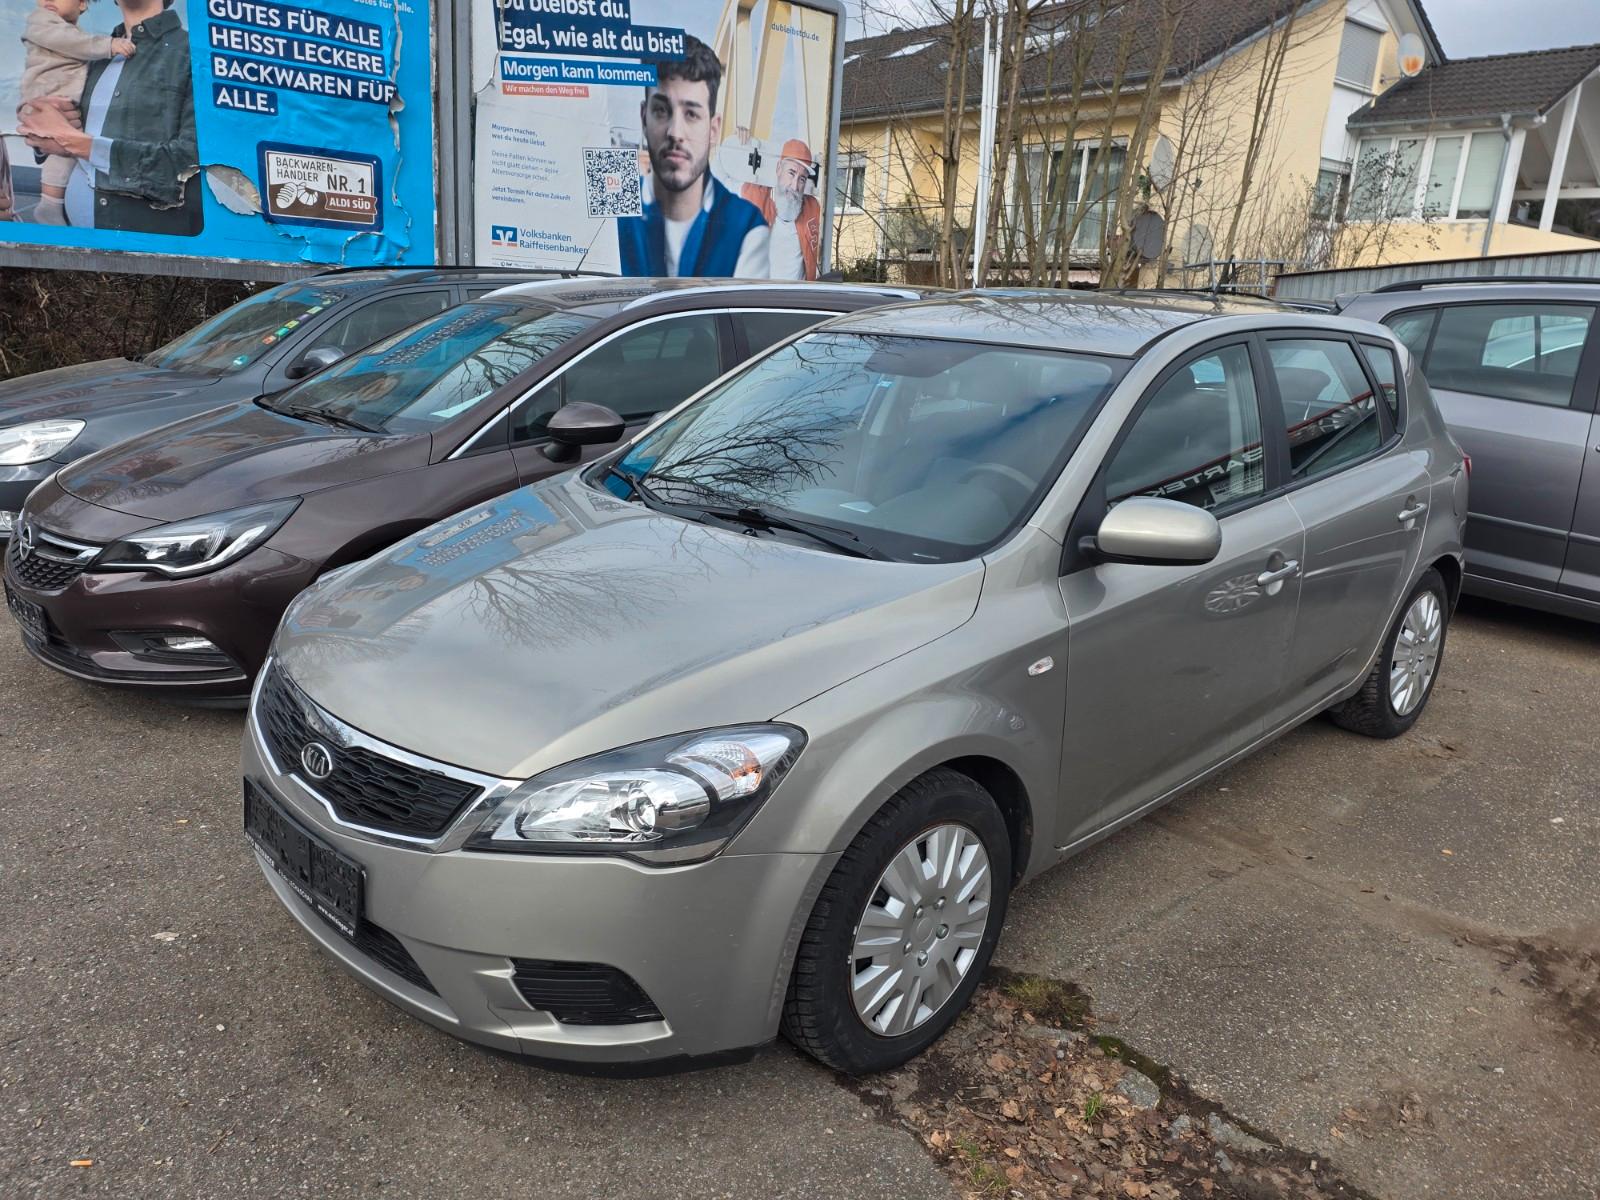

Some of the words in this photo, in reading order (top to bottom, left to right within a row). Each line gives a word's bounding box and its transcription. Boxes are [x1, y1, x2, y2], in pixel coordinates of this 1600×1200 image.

[600, 0, 630, 19] du.
[209, 0, 281, 28] GUTES
[287, 10, 330, 37] FÜR
[335, 22, 381, 48] ALLE
[502, 21, 550, 50] Egal,
[552, 25, 588, 48] wie
[592, 27, 618, 50] alt
[621, 29, 645, 52] du
[647, 31, 684, 55] bist!
[211, 26, 287, 57] HEISST
[293, 41, 383, 74] LECKERE
[213, 56, 352, 97] BACKWAREN
[503, 60, 558, 81] Morgen
[561, 62, 594, 80] kann
[597, 64, 655, 83] kommen.
[216, 87, 275, 113] ALLE.
[505, 84, 518, 92] Wir
[518, 85, 545, 94] machen
[545, 87, 558, 95] den
[558, 87, 574, 97] Weg
[574, 88, 587, 97] frei.
[491, 123, 514, 133] Morgen
[513, 136, 529, 144] heute
[275, 156, 338, 173] BACKWAREN-
[327, 174, 353, 193] NR.
[357, 177, 366, 194] 1
[606, 175, 621, 186] Du
[329, 197, 351, 209] ALDI
[352, 197, 371, 210] SÜD
[519, 228, 572, 243] Volksbanken
[519, 239, 589, 254] Raiffeisenbanken
[304, 745, 327, 777] KIA
